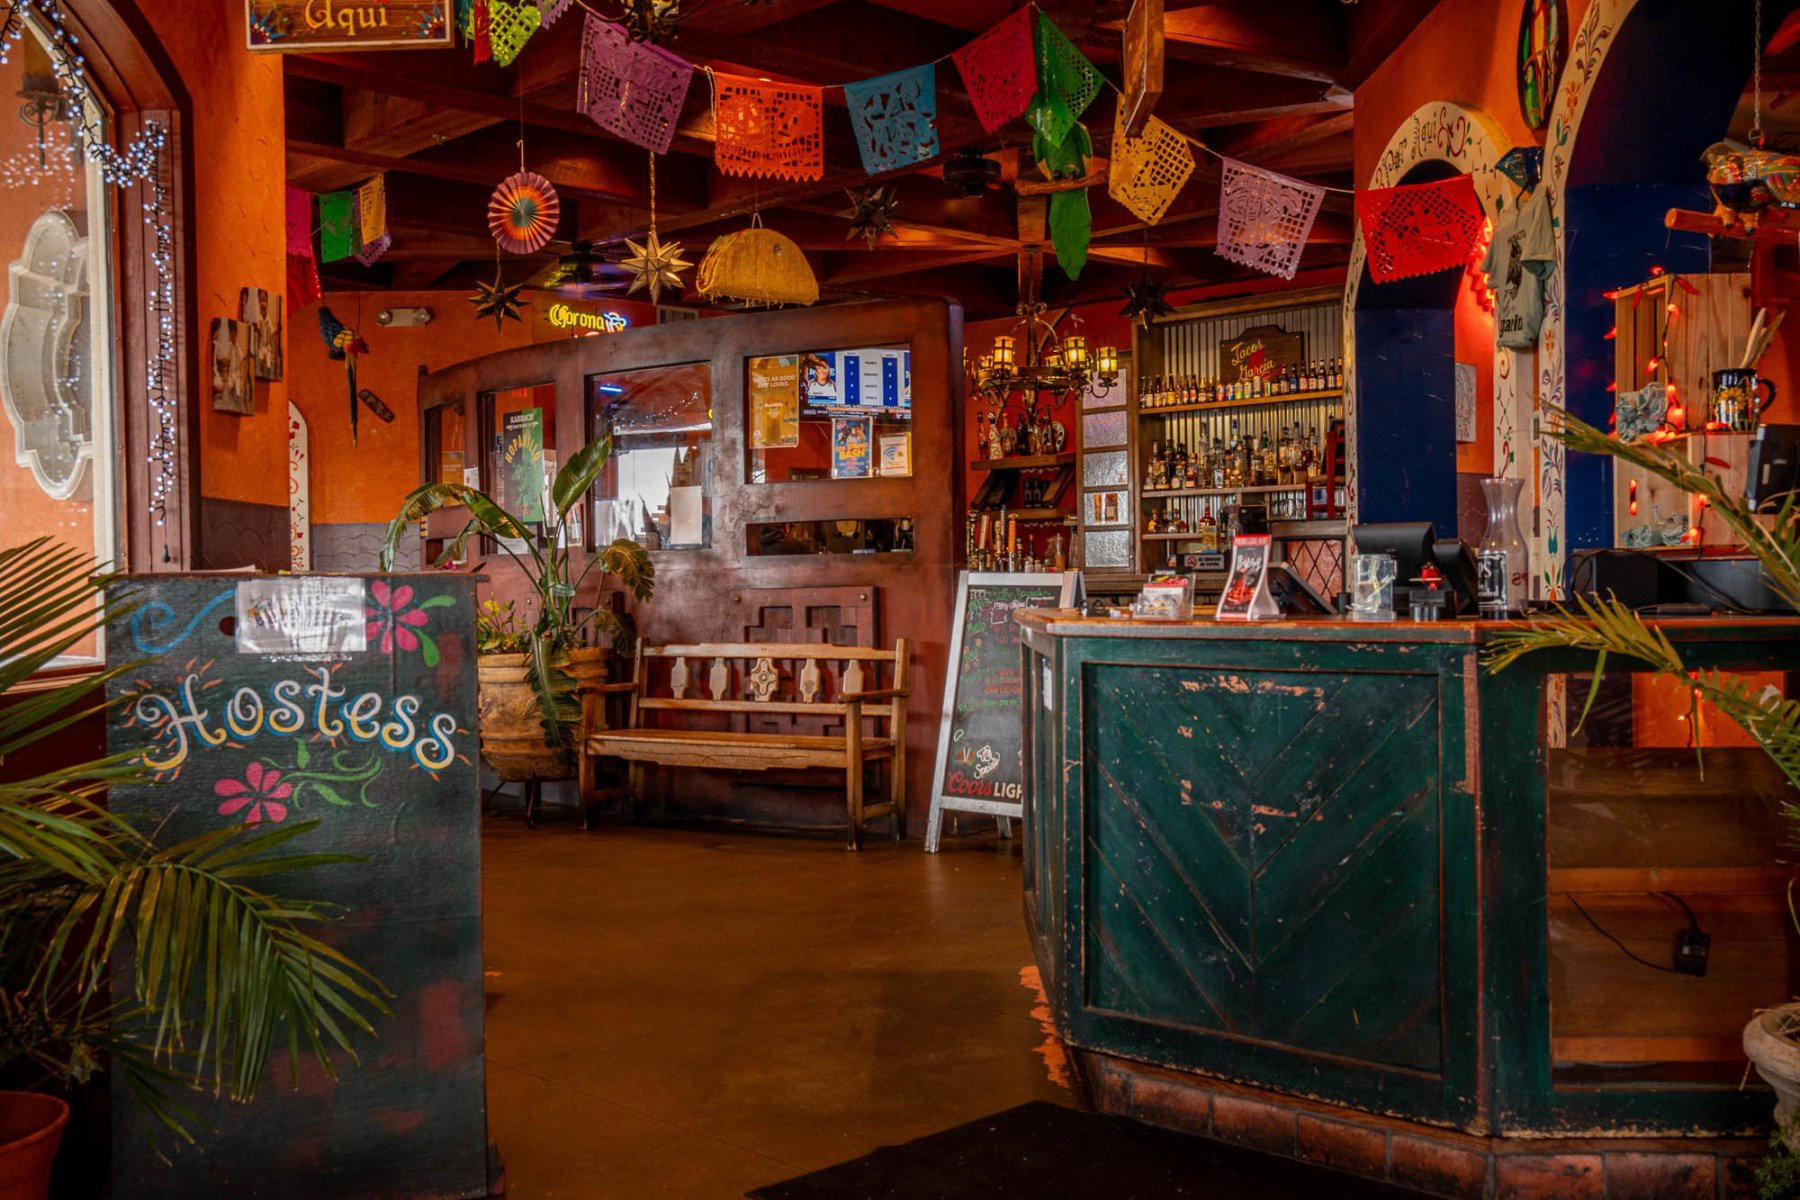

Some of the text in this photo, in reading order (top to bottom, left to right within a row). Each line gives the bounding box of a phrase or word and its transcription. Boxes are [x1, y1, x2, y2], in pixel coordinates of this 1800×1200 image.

[549, 303, 605, 331] Corona
[135, 666, 457, 772] Hostess
[948, 771, 993, 797] Coors
